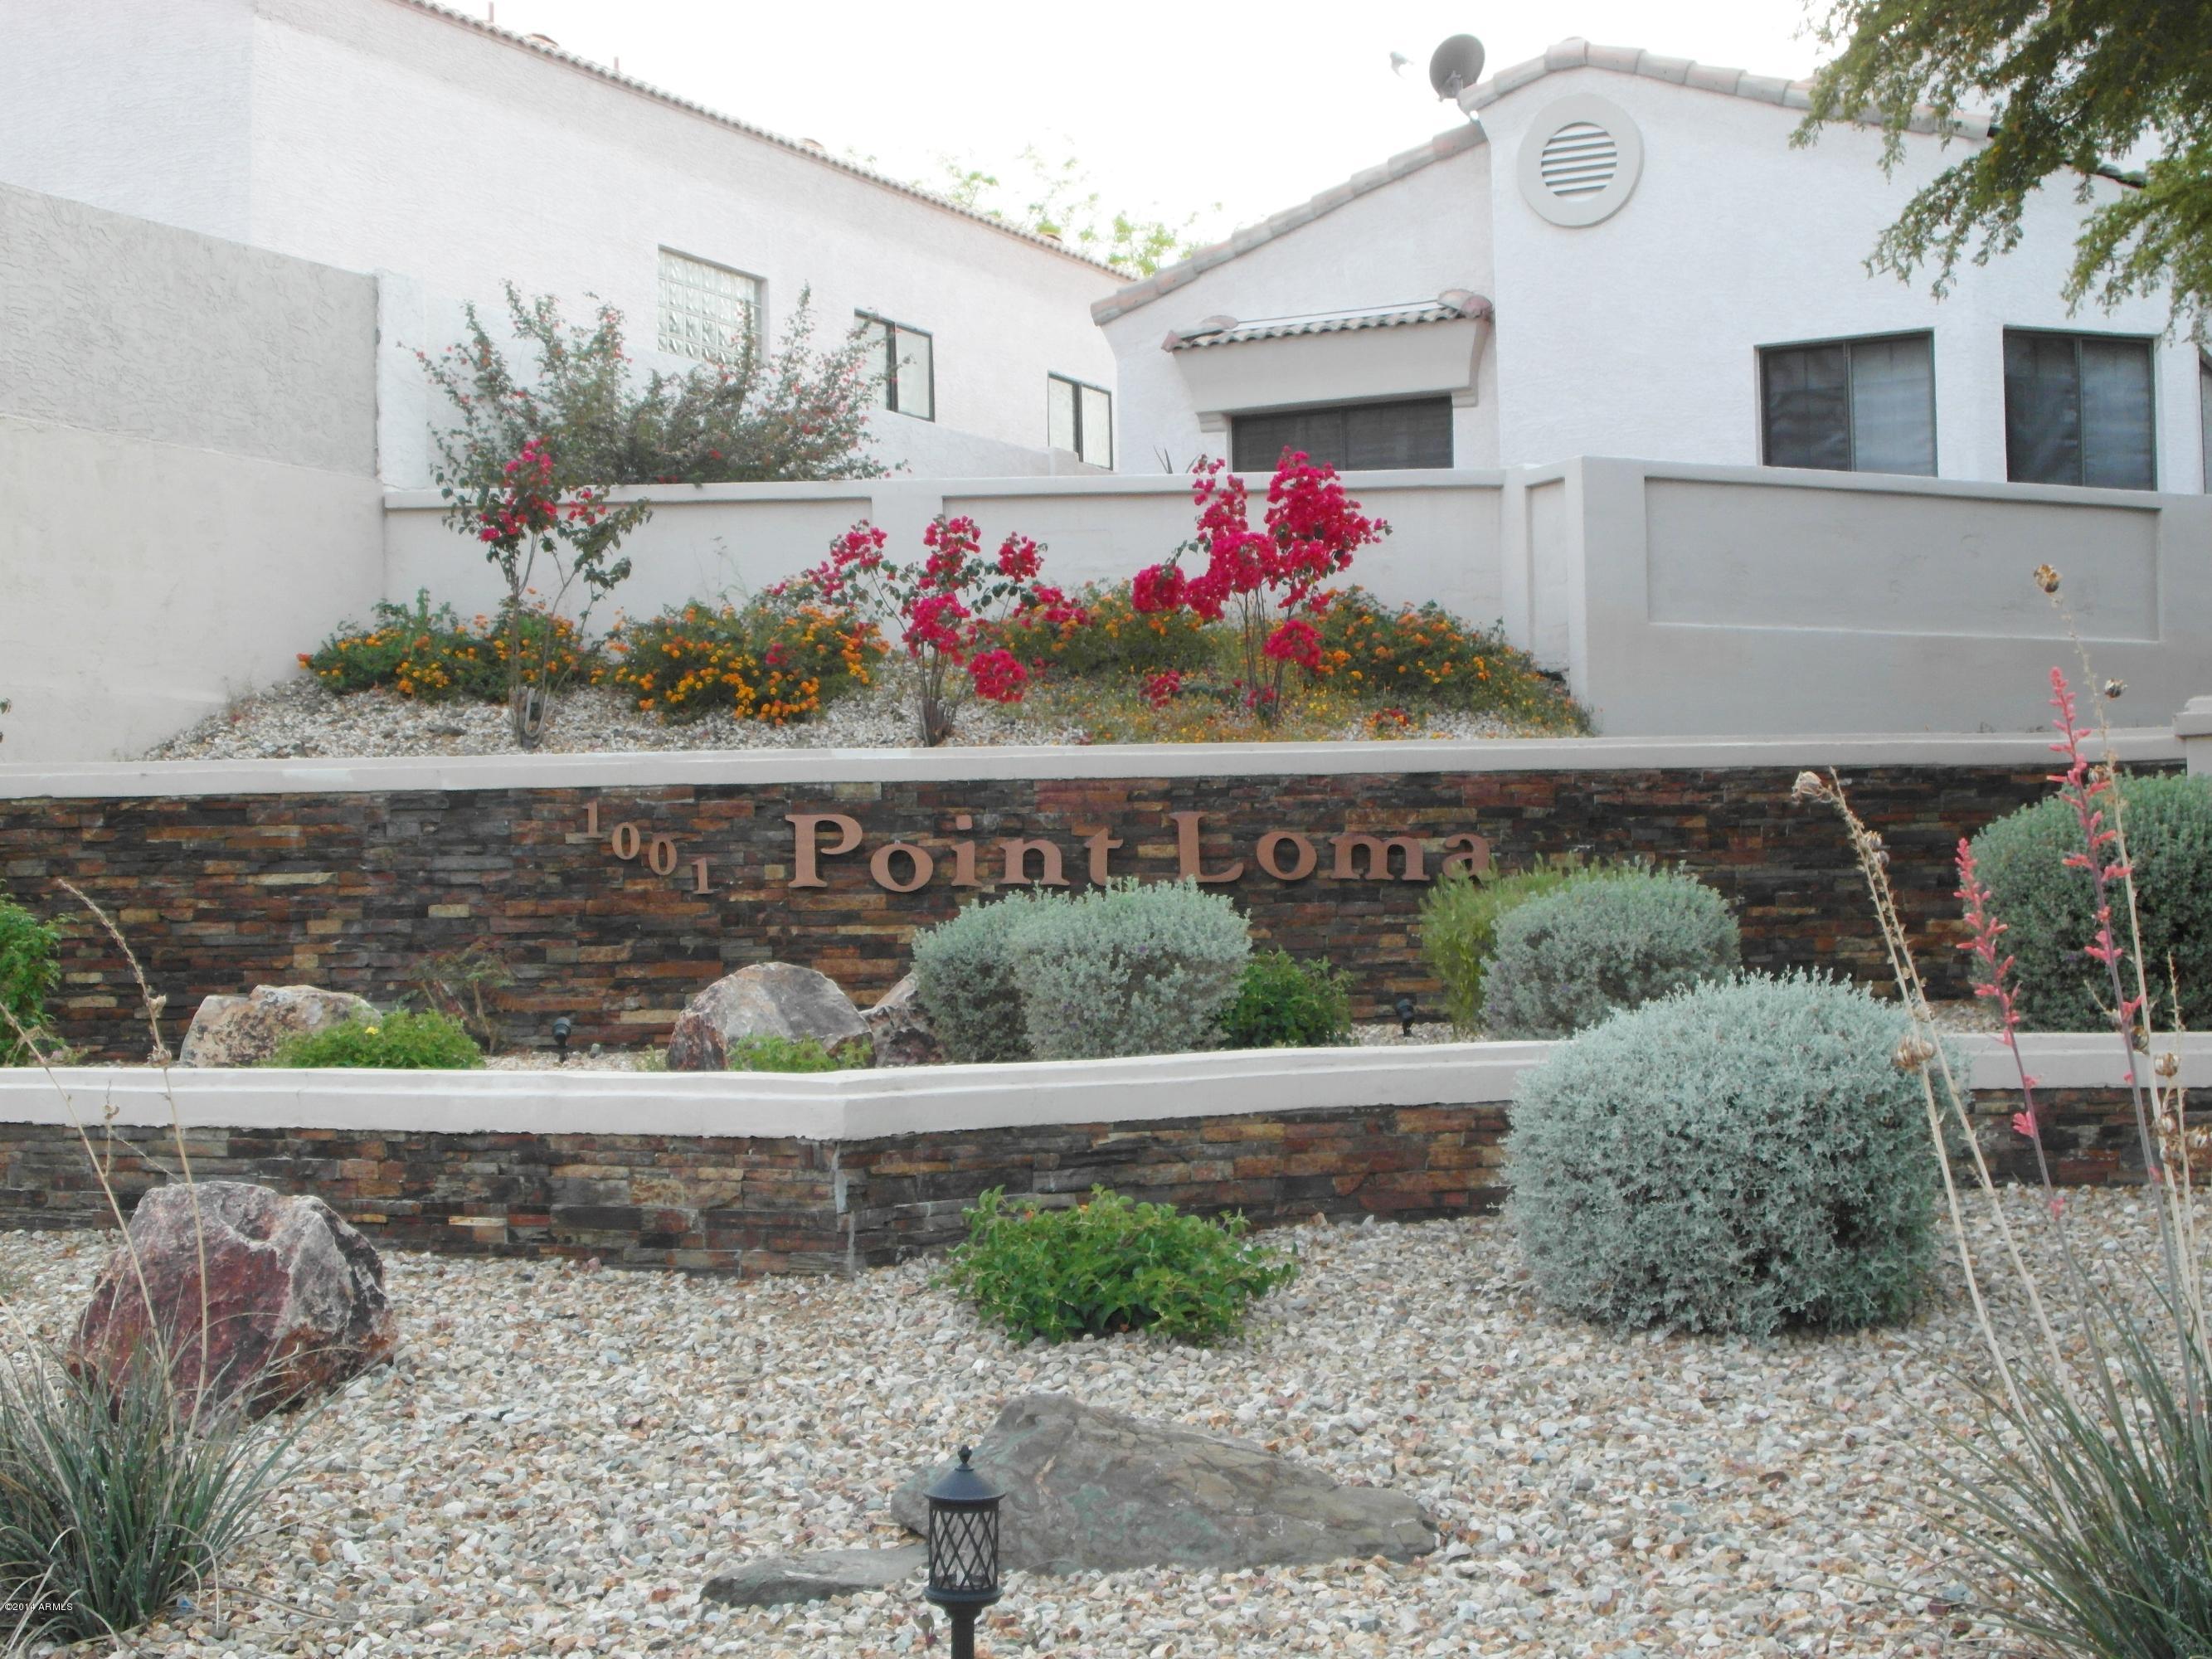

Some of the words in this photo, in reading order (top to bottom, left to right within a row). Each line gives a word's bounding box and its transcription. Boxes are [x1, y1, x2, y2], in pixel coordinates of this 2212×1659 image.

[582, 801, 711, 895] 1001
[785, 813, 1123, 893] Point
[1169, 810, 1493, 883] Loma
